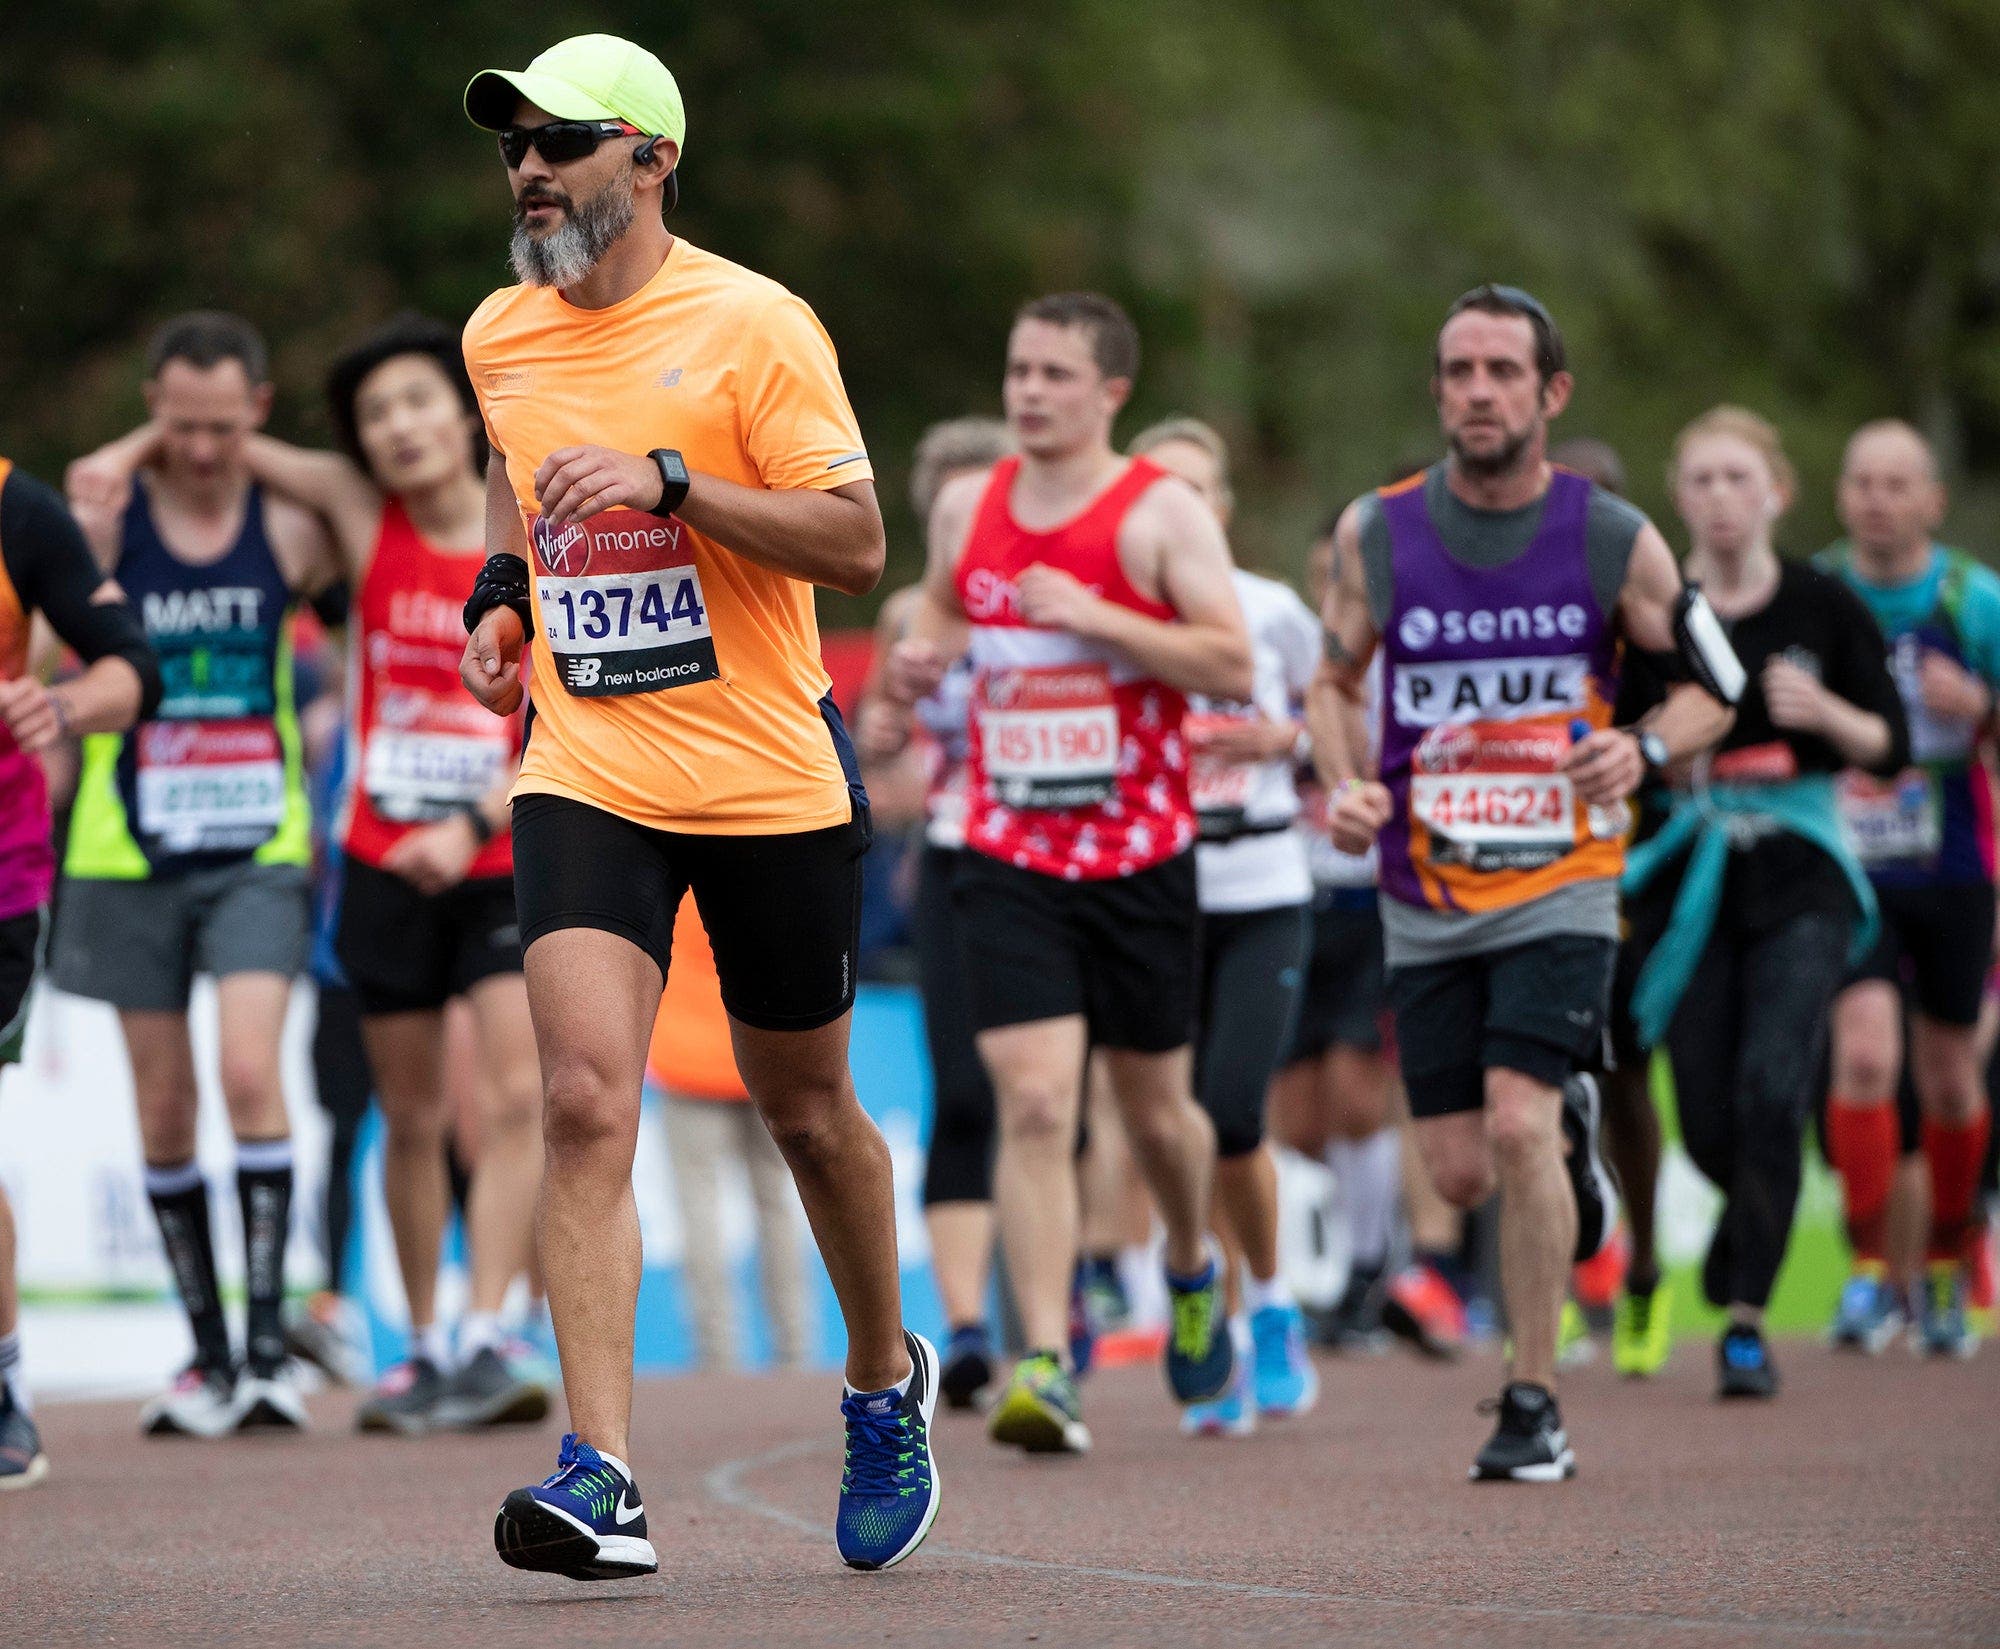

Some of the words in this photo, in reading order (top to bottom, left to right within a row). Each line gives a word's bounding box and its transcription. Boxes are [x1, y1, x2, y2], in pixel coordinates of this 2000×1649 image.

[539, 525, 584, 572] Virgin
[594, 526, 680, 551] money
[143, 587, 265, 635] MATT
[541, 589, 550, 600] M
[558, 578, 704, 640] 13744
[1442, 604, 1587, 644] sense
[604, 671, 633, 686] new
[636, 660, 701, 683] balance
[1411, 670, 1569, 709] PAUL
[1431, 785, 1562, 826] 44624
[867, 1398, 888, 1409] NIKE
